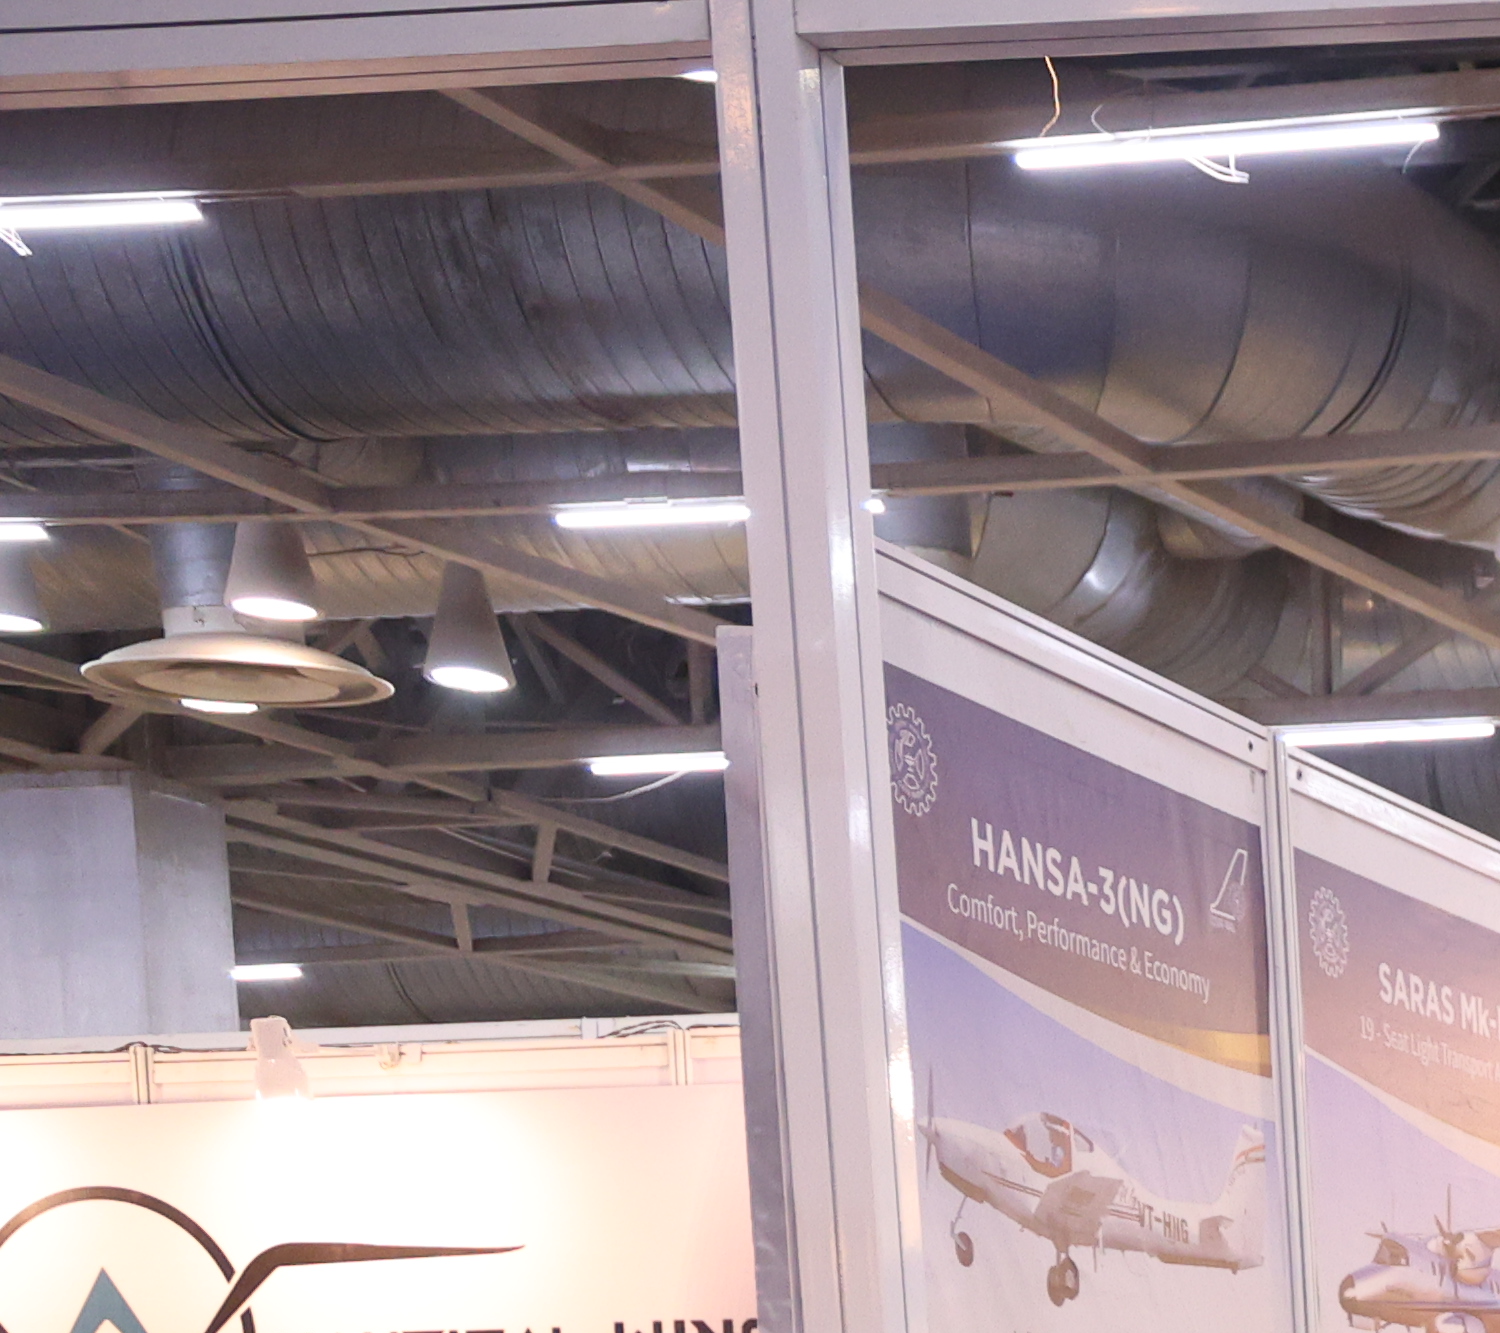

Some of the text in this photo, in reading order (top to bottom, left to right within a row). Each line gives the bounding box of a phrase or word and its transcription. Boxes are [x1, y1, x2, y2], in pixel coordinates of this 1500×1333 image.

[970, 817, 1185, 946] HANSA-3(NG)
[947, 884, 1211, 999] Comfort, Performance & Economy
[1378, 962, 1455, 1025] SARAS
[1138, 1202, 1190, 1245] VT-HNG
